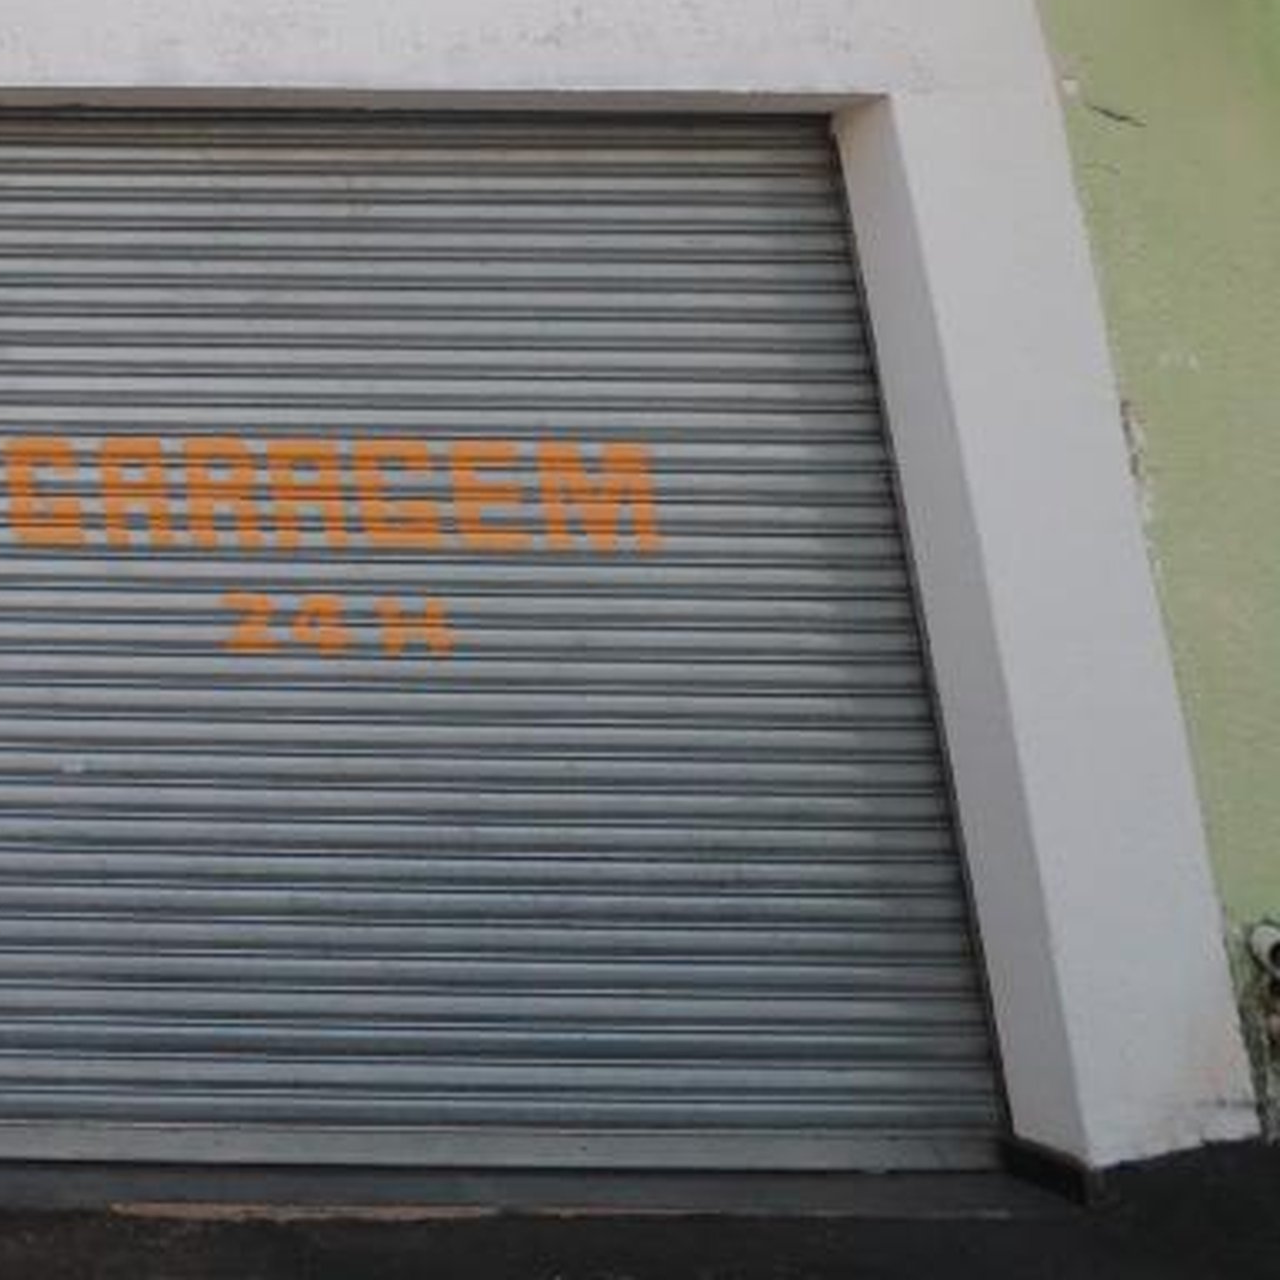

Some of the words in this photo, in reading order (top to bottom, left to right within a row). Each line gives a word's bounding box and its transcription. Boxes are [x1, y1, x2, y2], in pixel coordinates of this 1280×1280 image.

[2, 434, 665, 553] GARAGEM
[219, 590, 352, 657] 24
[374, 595, 456, 658] H
